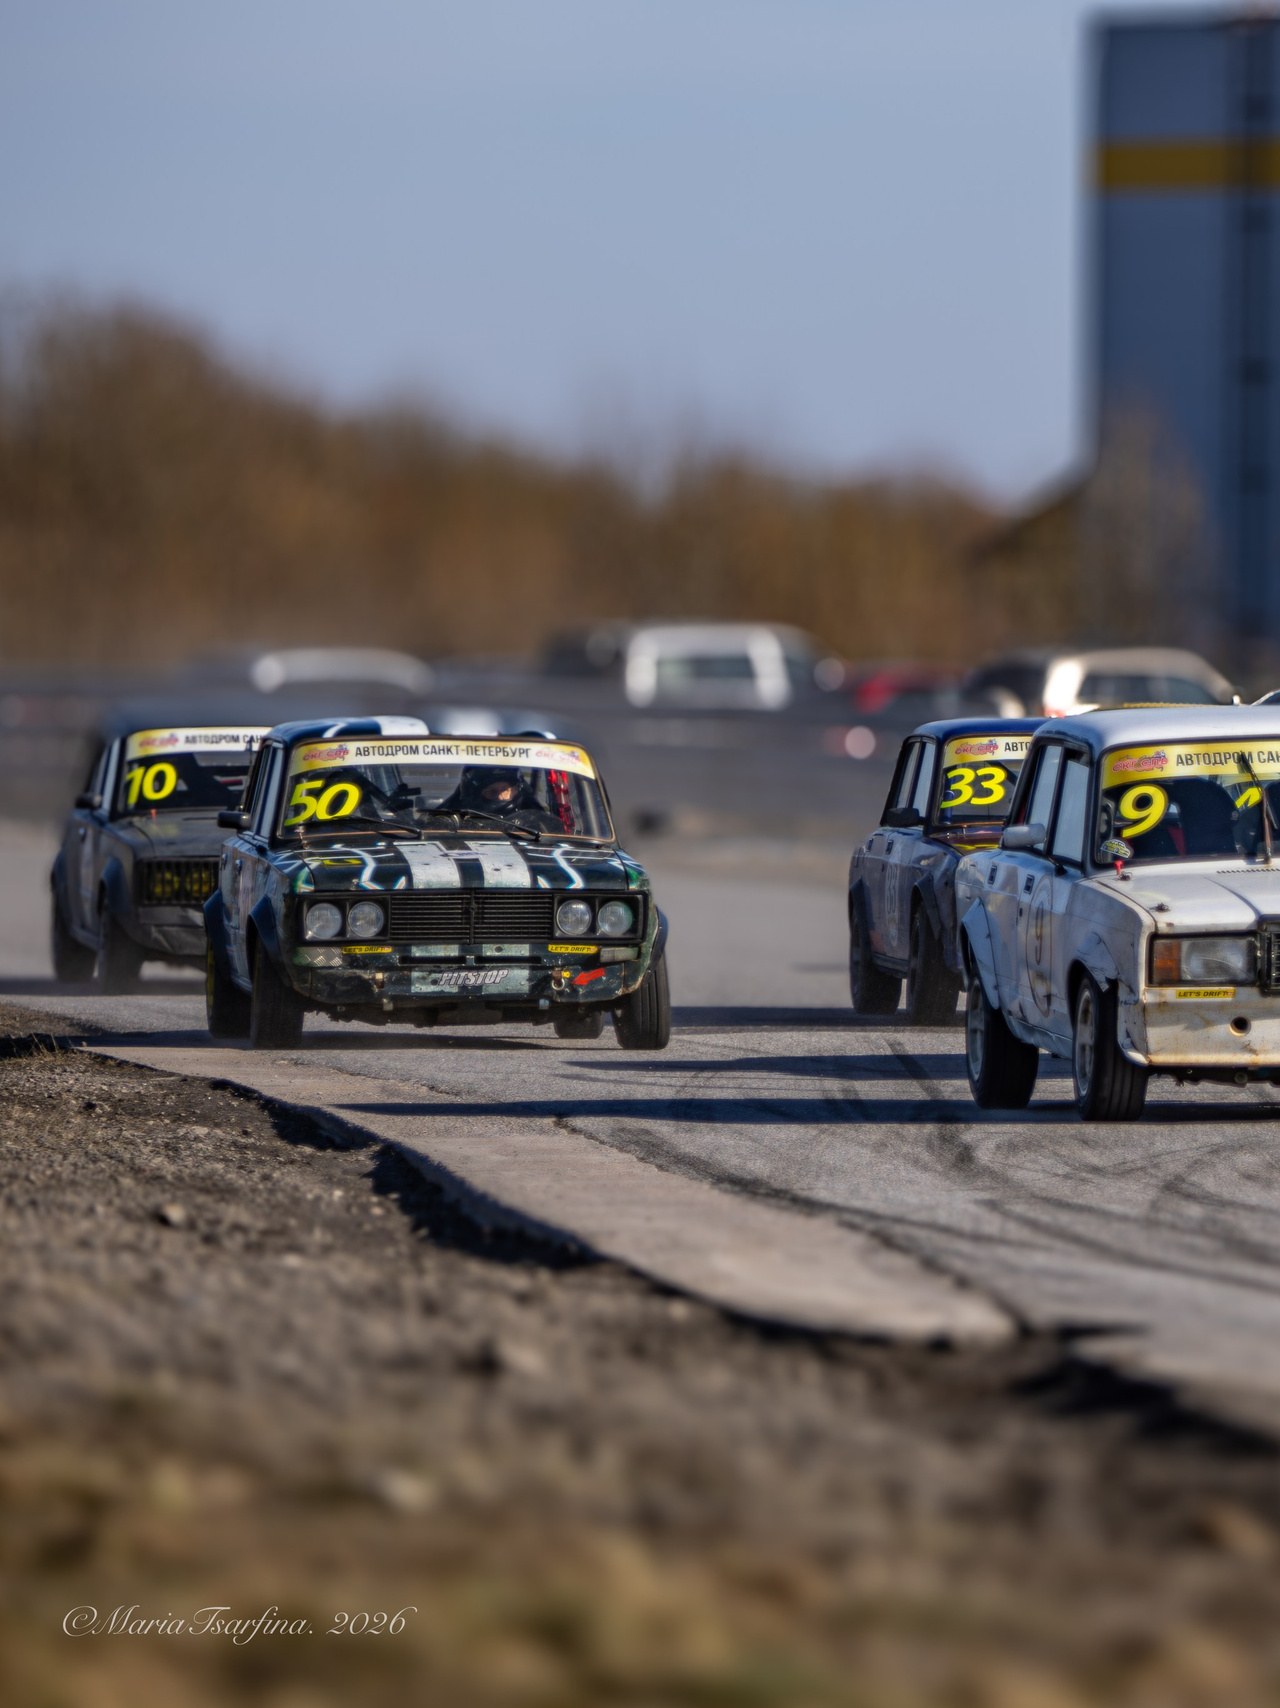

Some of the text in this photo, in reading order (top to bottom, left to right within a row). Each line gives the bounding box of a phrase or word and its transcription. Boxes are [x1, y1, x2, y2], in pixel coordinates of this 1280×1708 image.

[184, 735, 240, 744] АВТОДРОМ
[355, 744, 531, 758] АВТОДРОМ САНКТ-ПЕТЕРБУРГ
[1176, 751, 1254, 767] АВТОДРОМ
[125, 761, 178, 806] 10
[939, 766, 1008, 809] 33
[284, 779, 362, 828] 50
[1119, 783, 1168, 838] 9
[440, 969, 509, 987] PITSTOP
[1178, 989, 1228, 998] LET'S DRIFT
